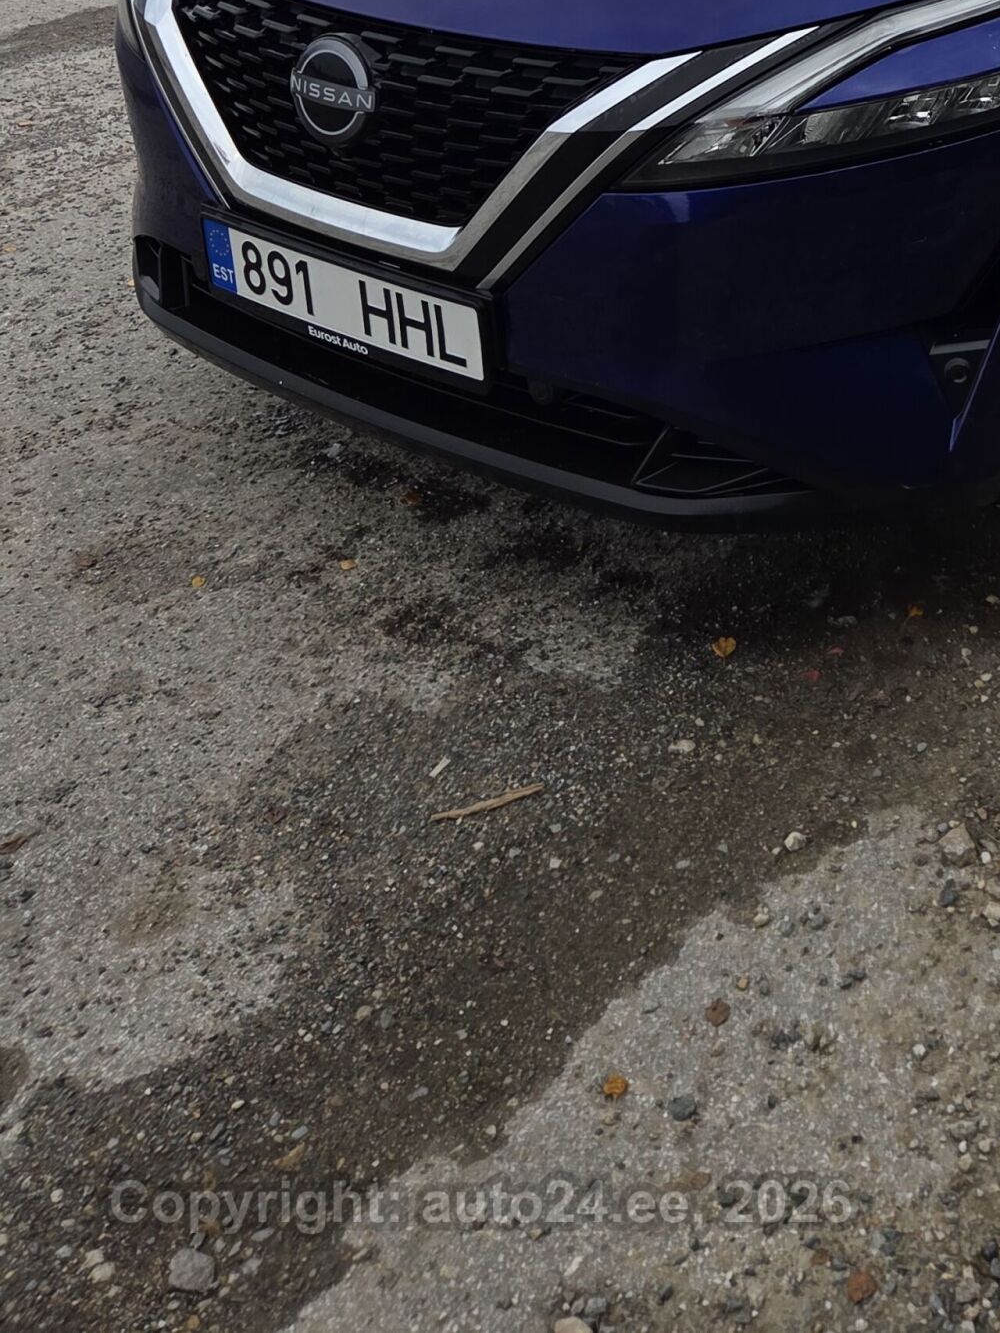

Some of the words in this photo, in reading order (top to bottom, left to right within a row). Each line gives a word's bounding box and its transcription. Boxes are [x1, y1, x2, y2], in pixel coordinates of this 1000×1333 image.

[290, 75, 373, 110] NISSAN
[213, 263, 235, 284] EST
[241, 240, 315, 316] 891
[358, 279, 467, 368] HHL
[308, 326, 342, 347] Eurost
[342, 339, 369, 356] Auto
